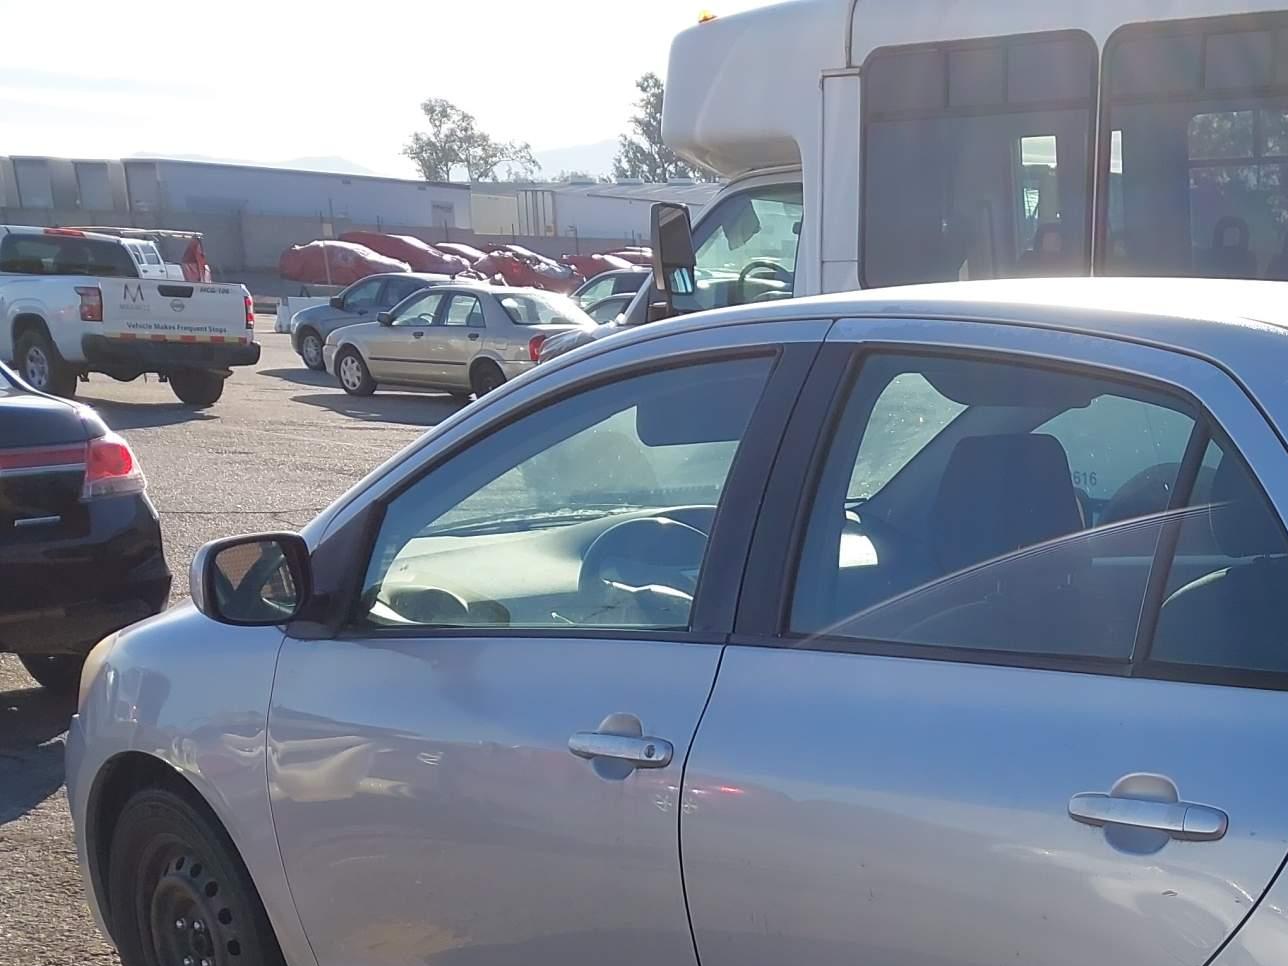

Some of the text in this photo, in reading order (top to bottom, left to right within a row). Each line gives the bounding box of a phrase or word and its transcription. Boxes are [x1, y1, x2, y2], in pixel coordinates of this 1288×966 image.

[126, 321, 227, 333] Vehicle Makes Frequent Stops
